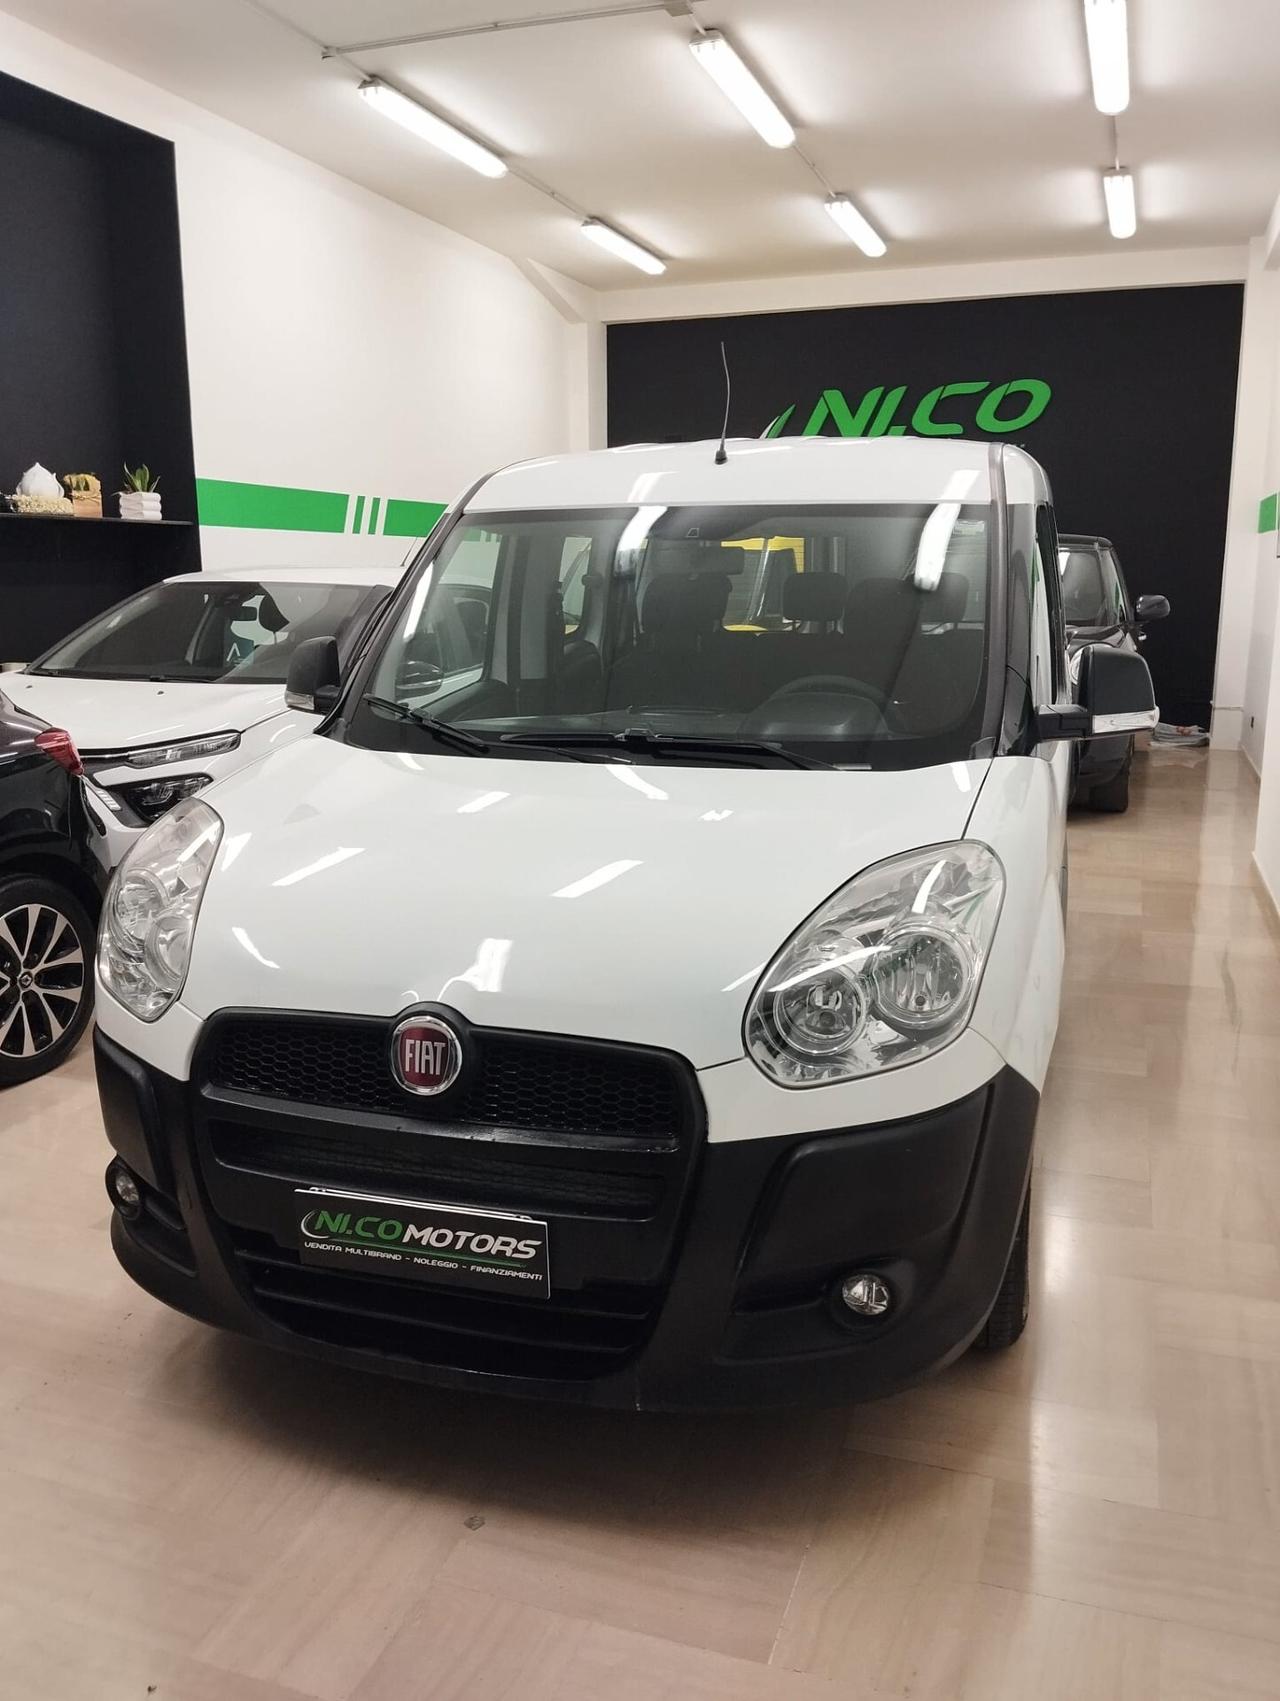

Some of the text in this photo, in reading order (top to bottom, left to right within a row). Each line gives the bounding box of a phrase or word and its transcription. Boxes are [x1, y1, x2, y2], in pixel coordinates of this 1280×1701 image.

[405, 1038, 447, 1075] FIAT
[304, 1241, 342, 1252] VENDITA
[345, 1247, 402, 1261] MULTIBRAND
[413, 1257, 459, 1269] NOLEGGIO
[470, 1265, 543, 1281] FINANZIAMENTI
